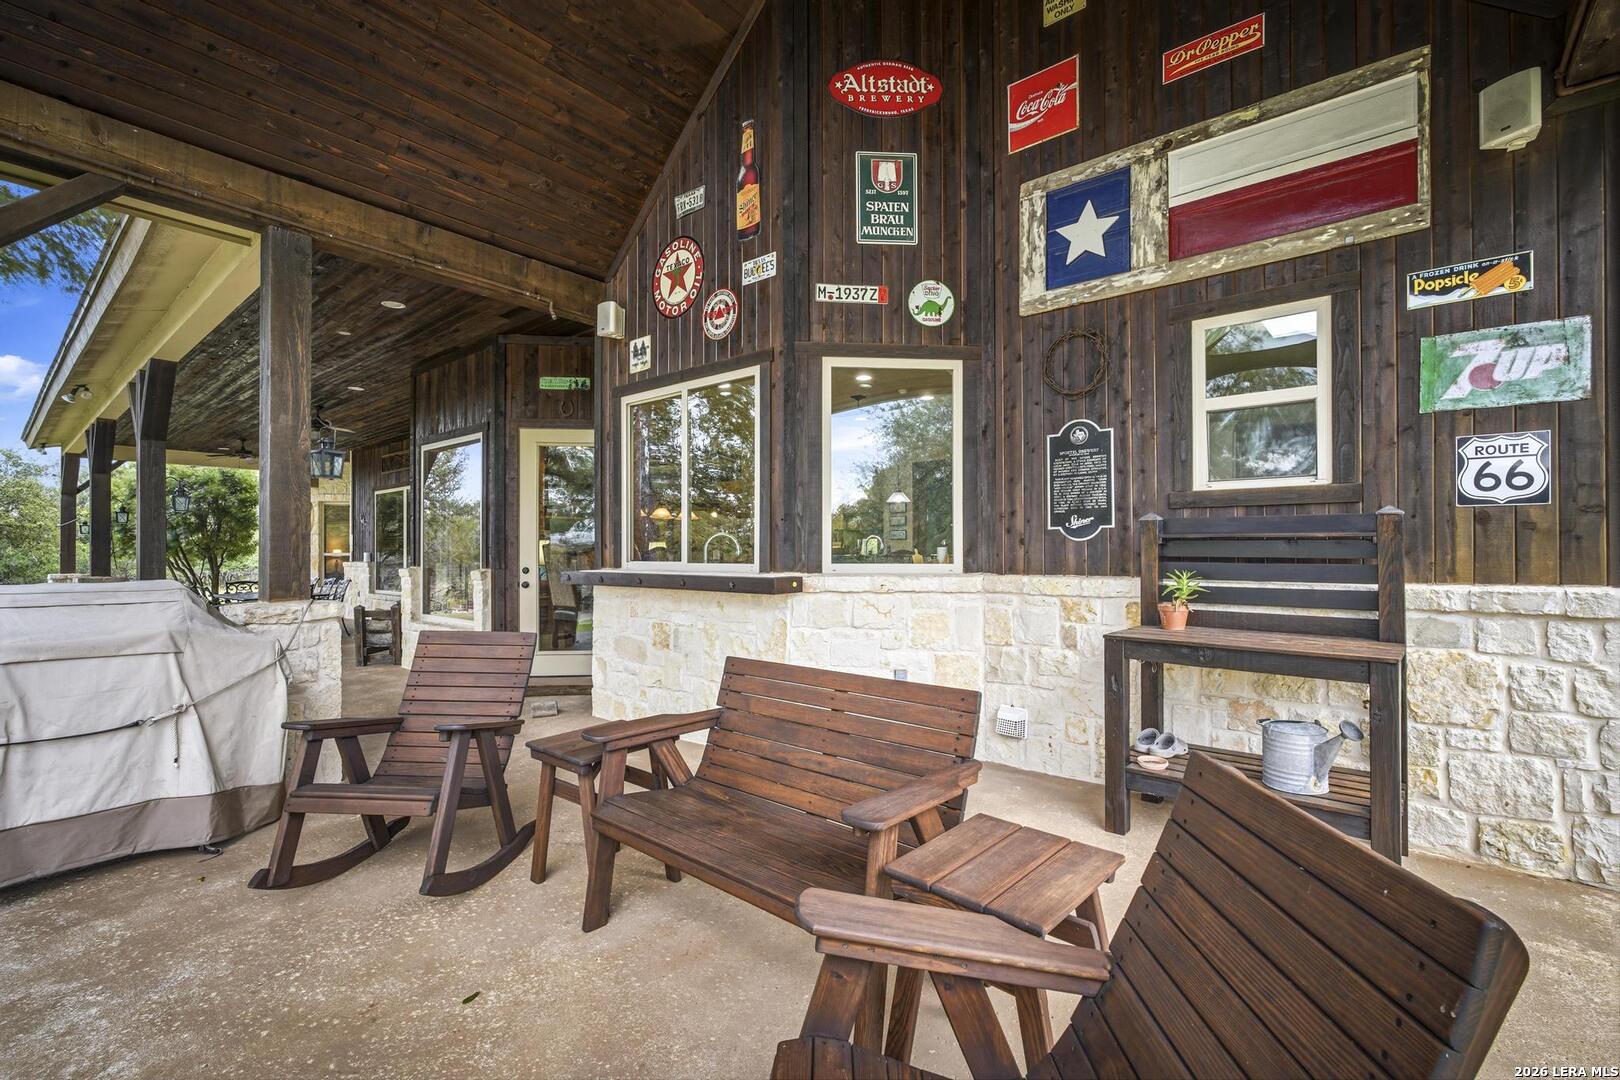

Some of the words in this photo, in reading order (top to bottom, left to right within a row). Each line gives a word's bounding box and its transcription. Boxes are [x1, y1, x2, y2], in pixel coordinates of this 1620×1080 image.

[1055, 3, 1075, 18] ONLY
[1197, 23, 1259, 56] Pepper
[841, 73, 928, 94] Altstadt
[848, 94, 925, 103] BREWERY
[866, 201, 909, 212] SPATEN
[870, 213, 904, 225] BRÄU
[861, 225, 914, 236] MÜNCHEN
[655, 240, 701, 278] GASOLINE
[666, 257, 690, 272] TEXACO
[1420, 267, 1451, 279] FROZEN
[1453, 262, 1479, 272] DRINK
[1413, 270, 1480, 295] Popsicle
[654, 289, 687, 315] MOTOR
[689, 272, 702, 299] OIL
[1474, 442, 1530, 456] ROUTE
[1473, 459, 1535, 492] 66
